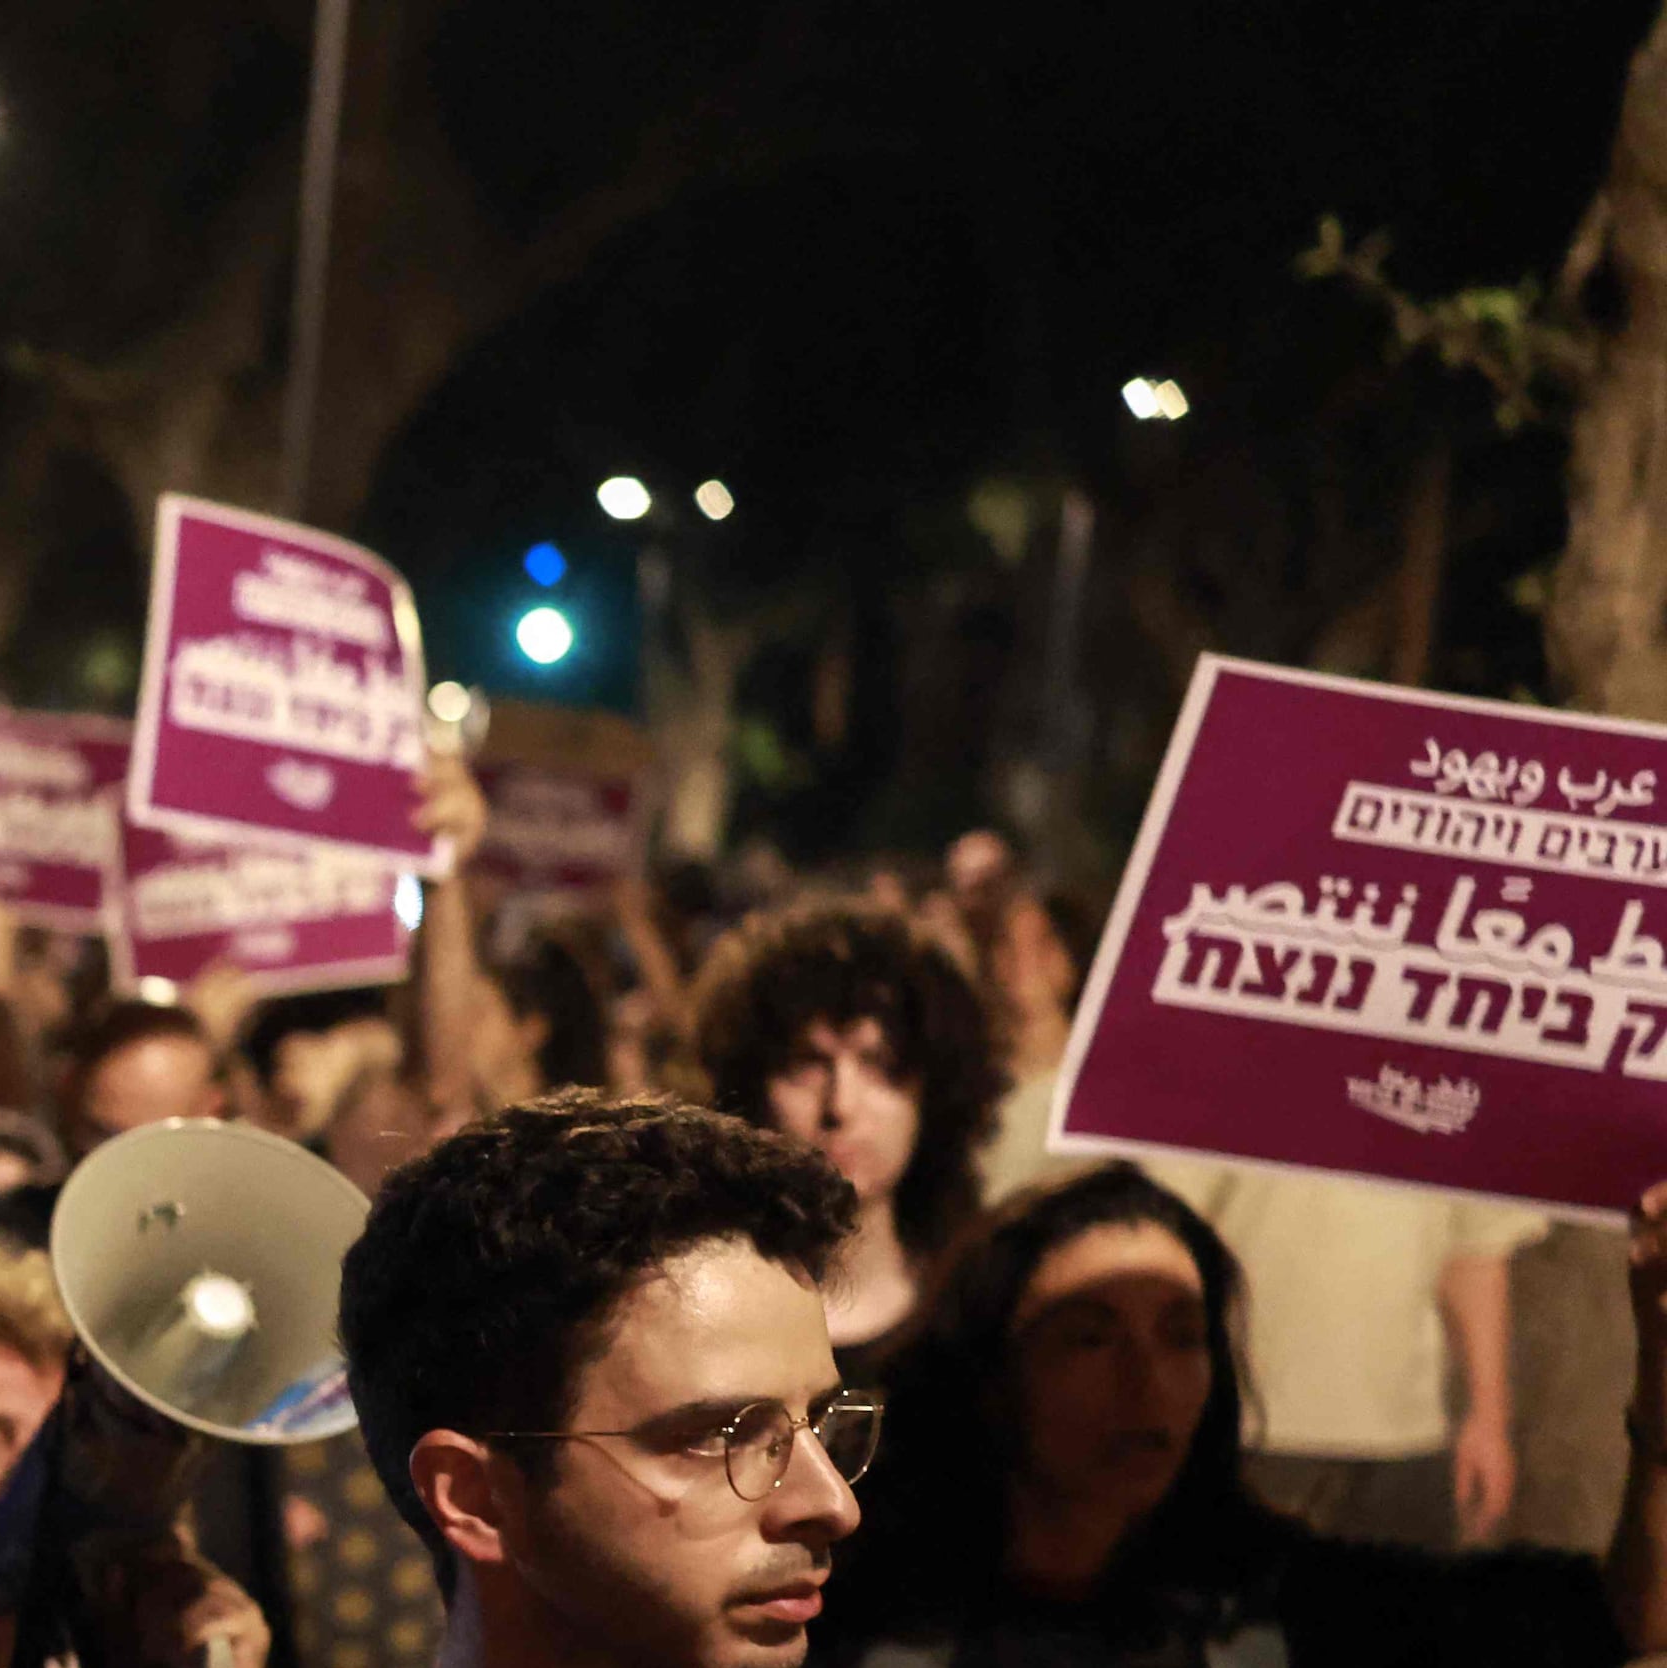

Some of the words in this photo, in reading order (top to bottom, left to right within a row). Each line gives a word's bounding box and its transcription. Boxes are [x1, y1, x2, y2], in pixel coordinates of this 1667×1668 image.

[1409, 737, 1546, 806] ويهود
[1557, 765, 1657, 817] عرب
[1348, 795, 1523, 853] ויהודים
[1162, 874, 1419, 950] ننتصر
[1179, 930, 1378, 1014] ננצח
[1400, 964, 1595, 1048] ביחד
